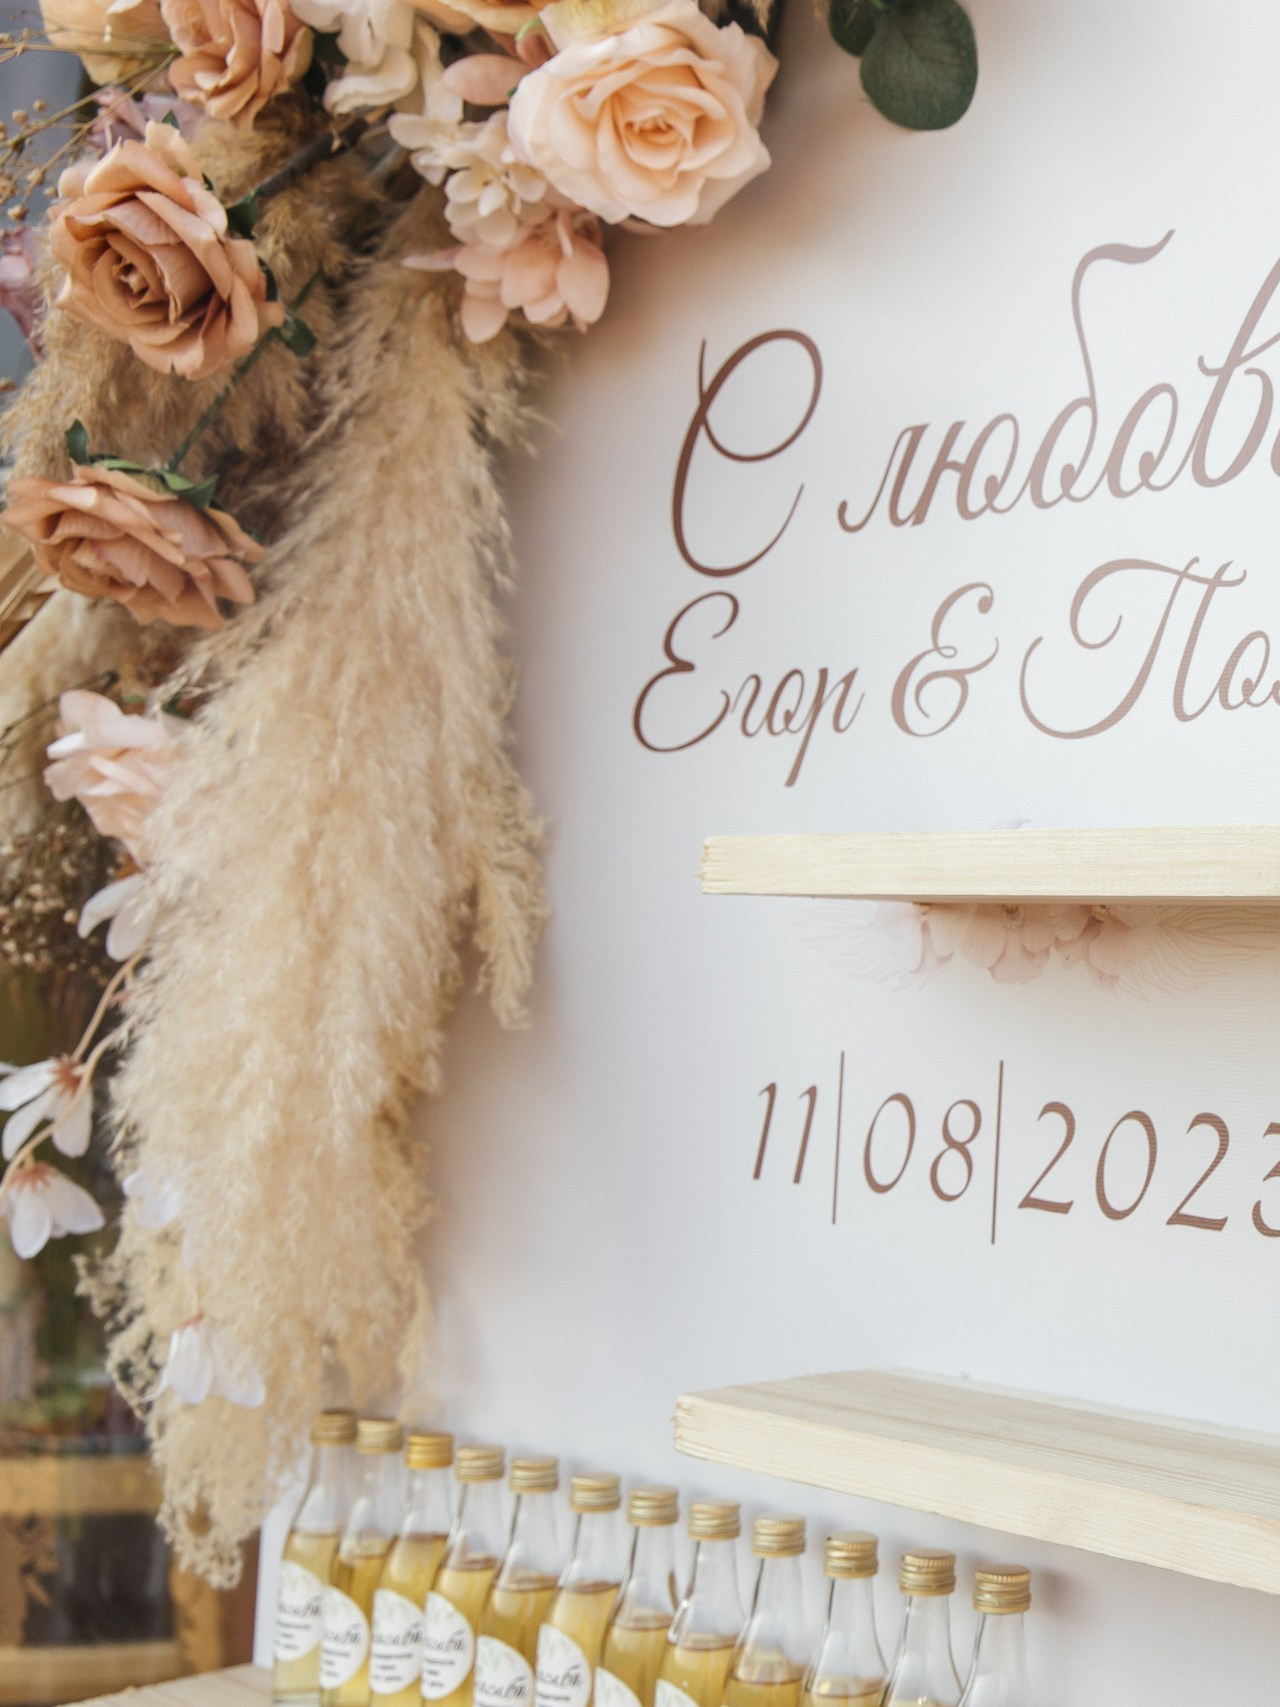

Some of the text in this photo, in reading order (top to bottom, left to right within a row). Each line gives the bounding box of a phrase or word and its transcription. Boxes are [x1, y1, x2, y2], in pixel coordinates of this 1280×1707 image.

[670, 328, 824, 578] С
[631, 590, 866, 788] Егор
[889, 582, 1000, 738] &
